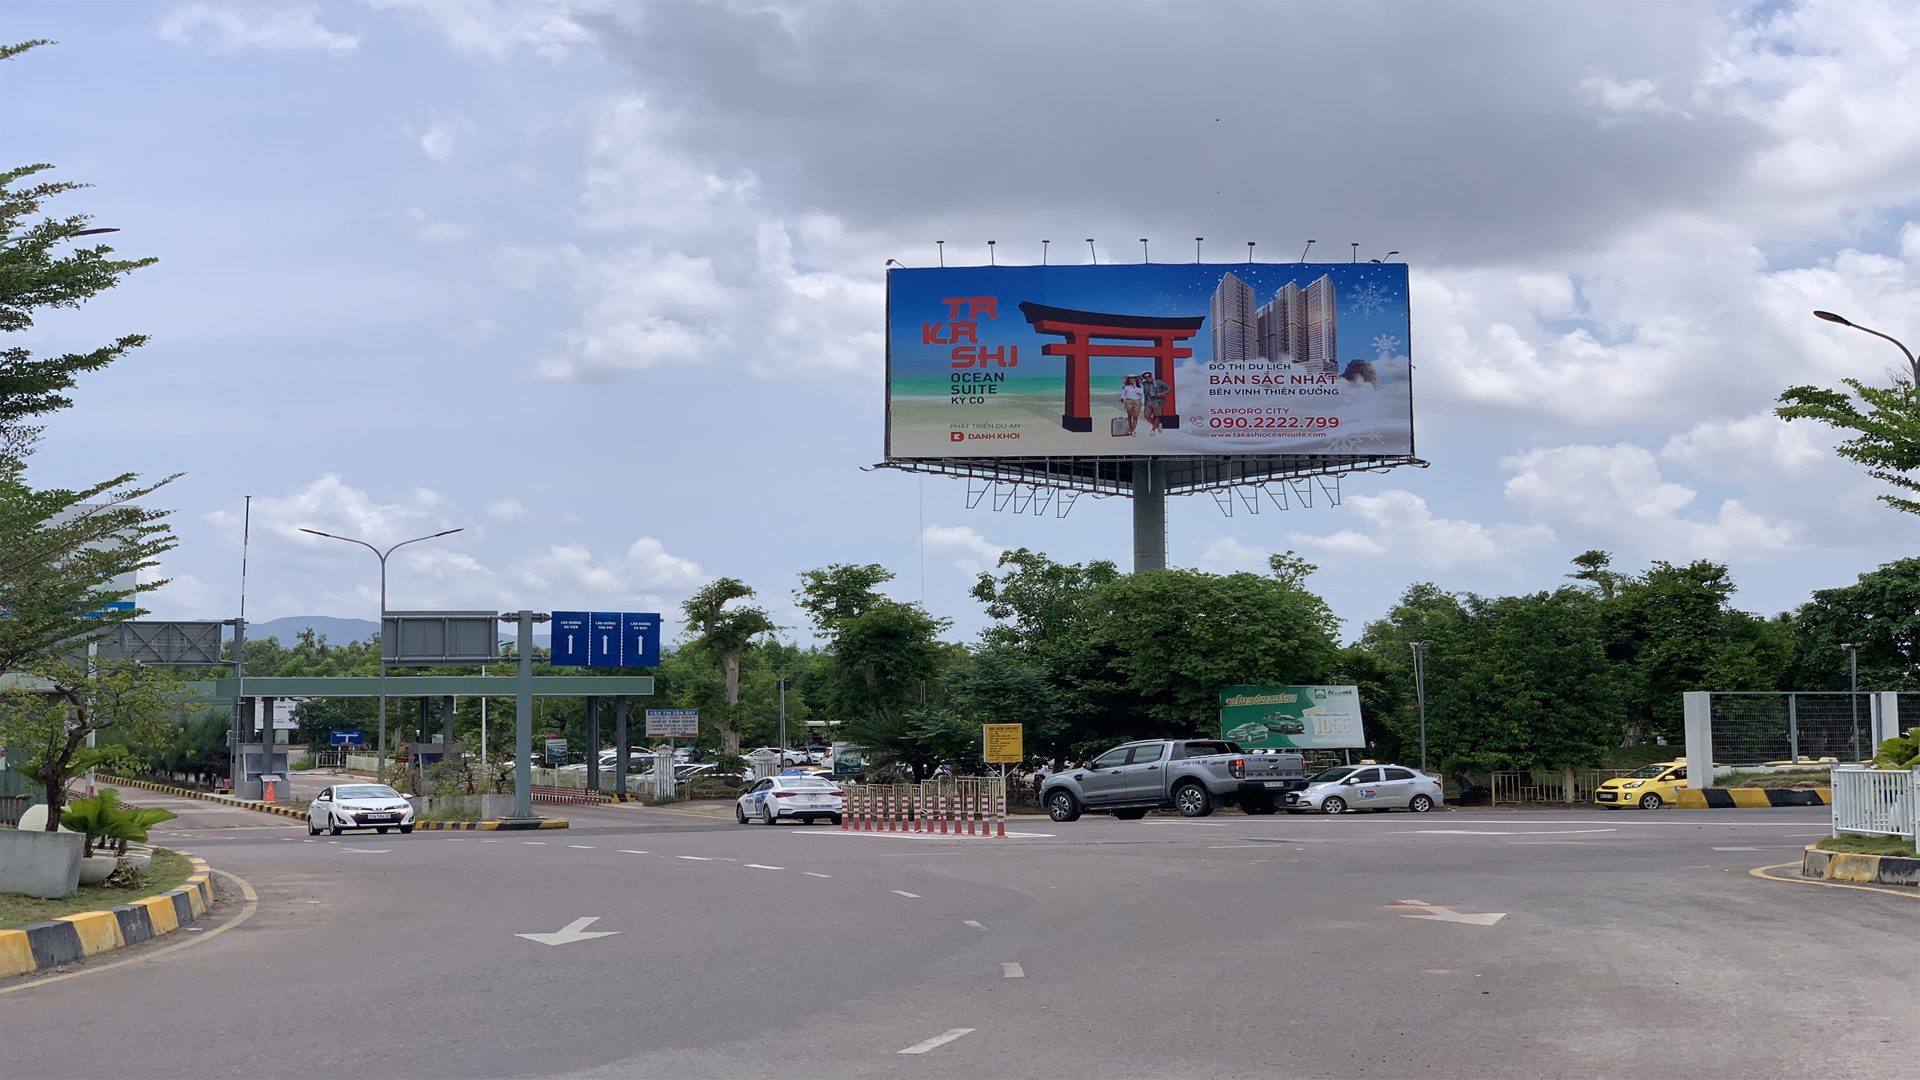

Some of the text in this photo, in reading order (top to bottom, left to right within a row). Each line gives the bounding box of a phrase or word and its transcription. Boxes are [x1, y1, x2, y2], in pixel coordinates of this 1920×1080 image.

[942, 296, 998, 319] TA
[922, 321, 978, 344] KA
[951, 346, 1018, 368] SHI
[1209, 362, 1225, 370] ĐÔ
[1228, 363, 1245, 372] THỊ
[1266, 363, 1291, 372] LỊCH
[950, 372, 1005, 383] OCEAN
[1209, 371, 1246, 385] BẢN
[1251, 370, 1285, 385] SẮC
[950, 384, 998, 395] SUITE
[1209, 386, 1340, 397] BÊN VỊNH THIÊN ĐƯỜNG
[969, 396, 985, 404] CO
[1209, 416, 1340, 428] 090.2222.799
[1313, 717, 1352, 734] 1055
